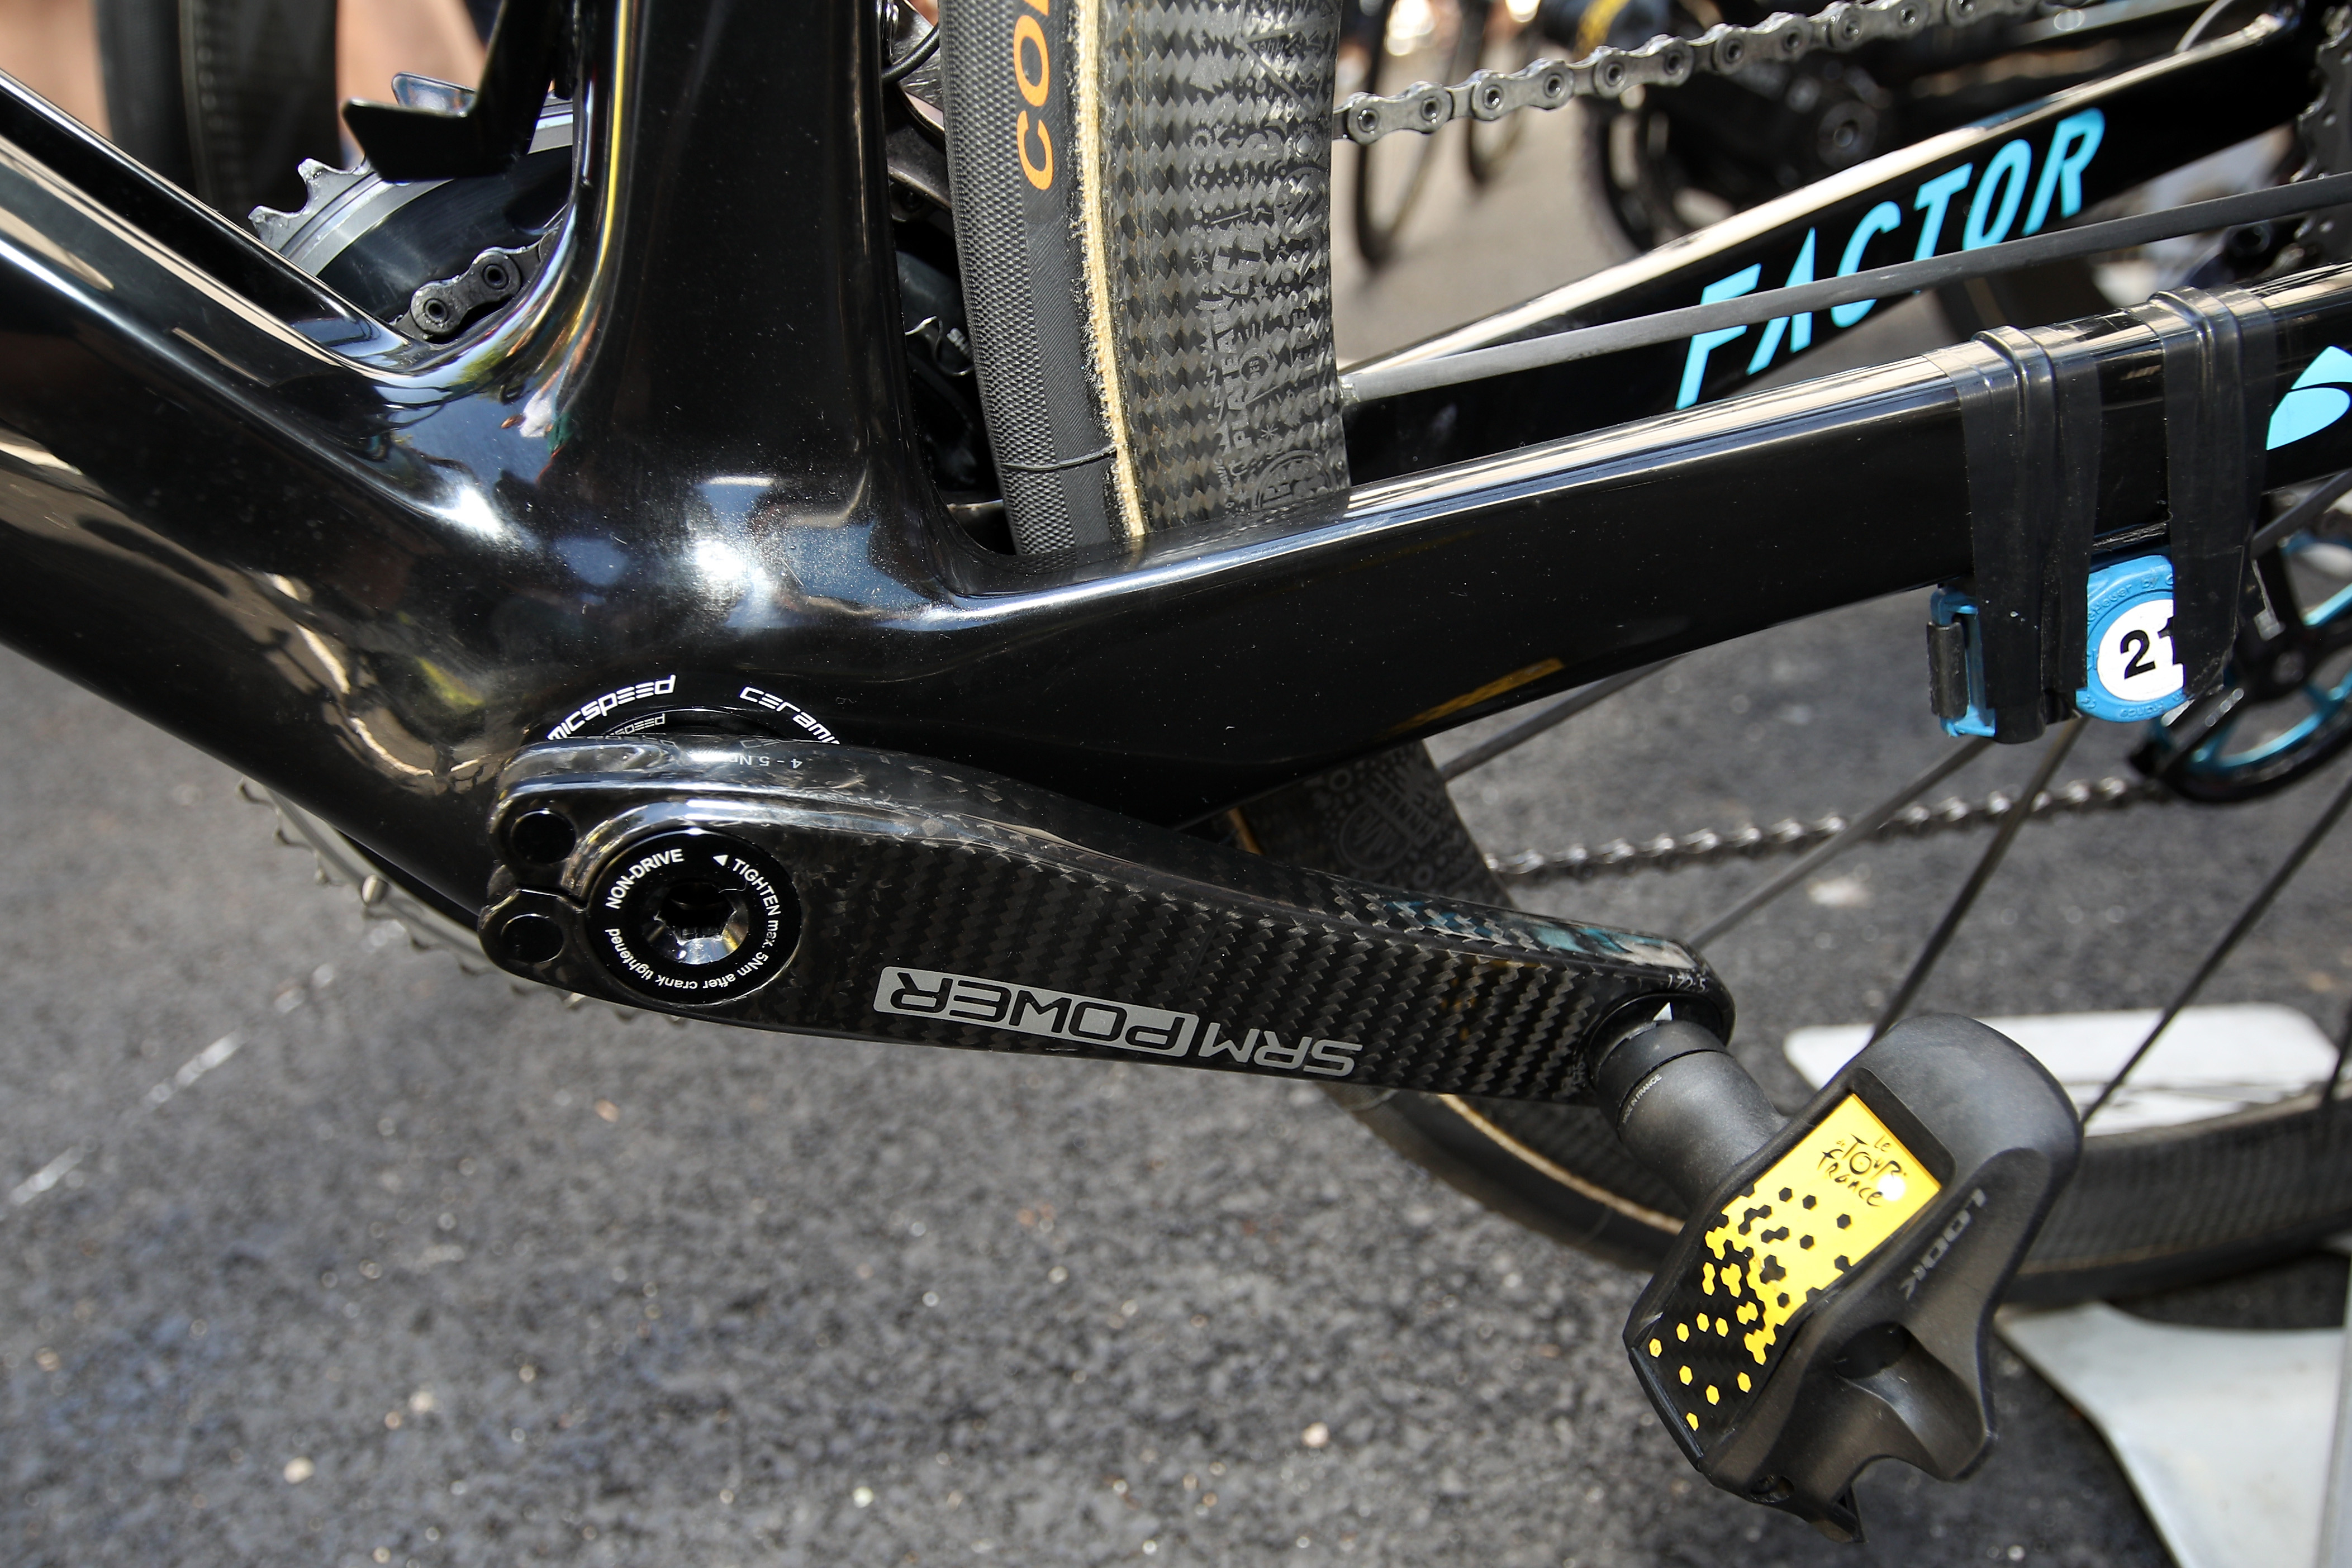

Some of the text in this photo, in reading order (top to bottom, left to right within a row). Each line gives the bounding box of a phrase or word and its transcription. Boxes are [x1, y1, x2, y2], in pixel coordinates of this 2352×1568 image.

[1013, 0, 1054, 190] CO
[1676, 108, 2105, 410] FACTOR
[739, 687, 840, 744] cerami
[758, 756, 770, 767] 5
[791, 758, 802, 769] 4
[605, 848, 685, 909] NON-DRIVE
[605, 858, 781, 989] TIGHTEN max. 5Nm after crank tightened
[890, 972, 1363, 1077] SRM POWER
[1635, 1073, 1662, 1100] FRANCE
[1899, 1188, 1985, 1300] LOOK
